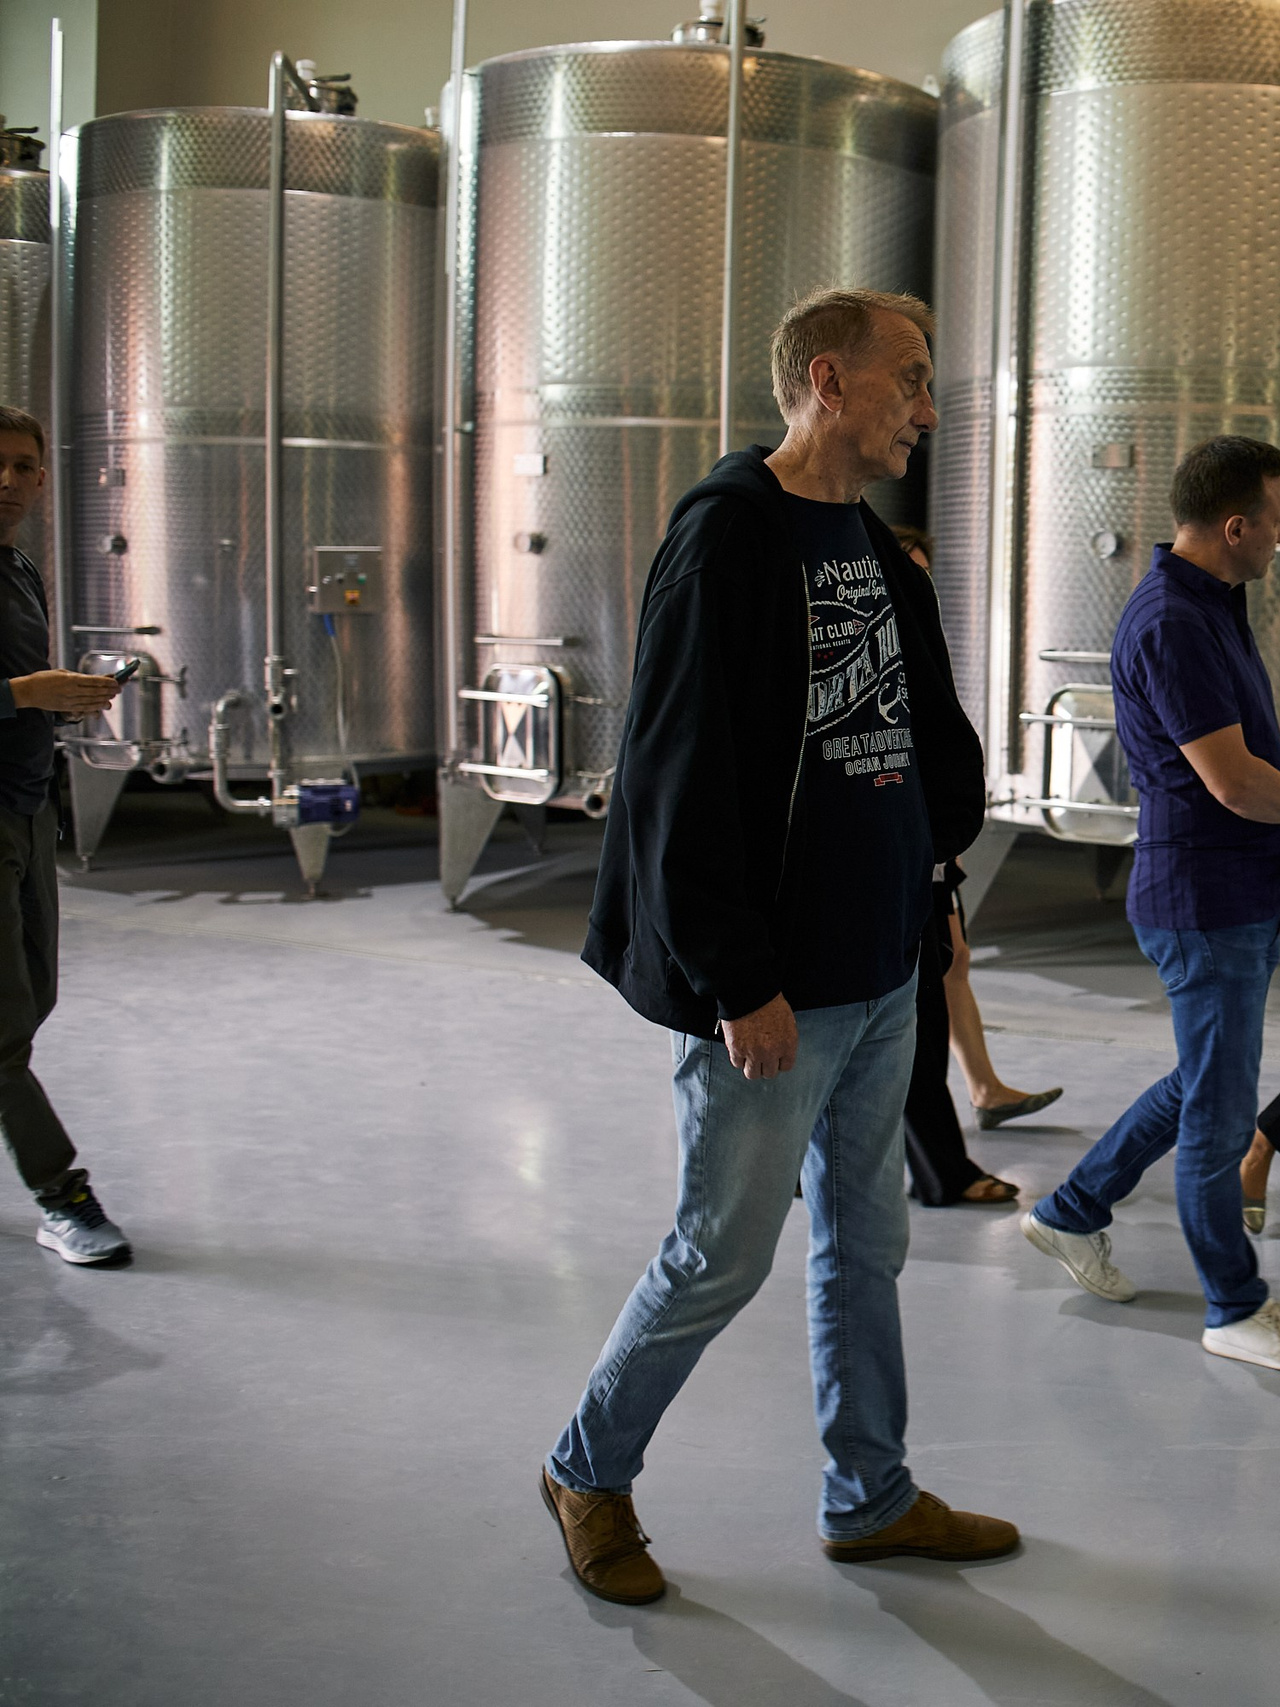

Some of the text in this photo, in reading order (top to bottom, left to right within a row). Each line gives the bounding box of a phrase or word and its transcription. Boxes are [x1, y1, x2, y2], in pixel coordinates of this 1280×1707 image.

[826, 621, 854, 640] CLUB
[822, 732, 870, 761] GREAT
[844, 756, 882, 776] OCEAN
